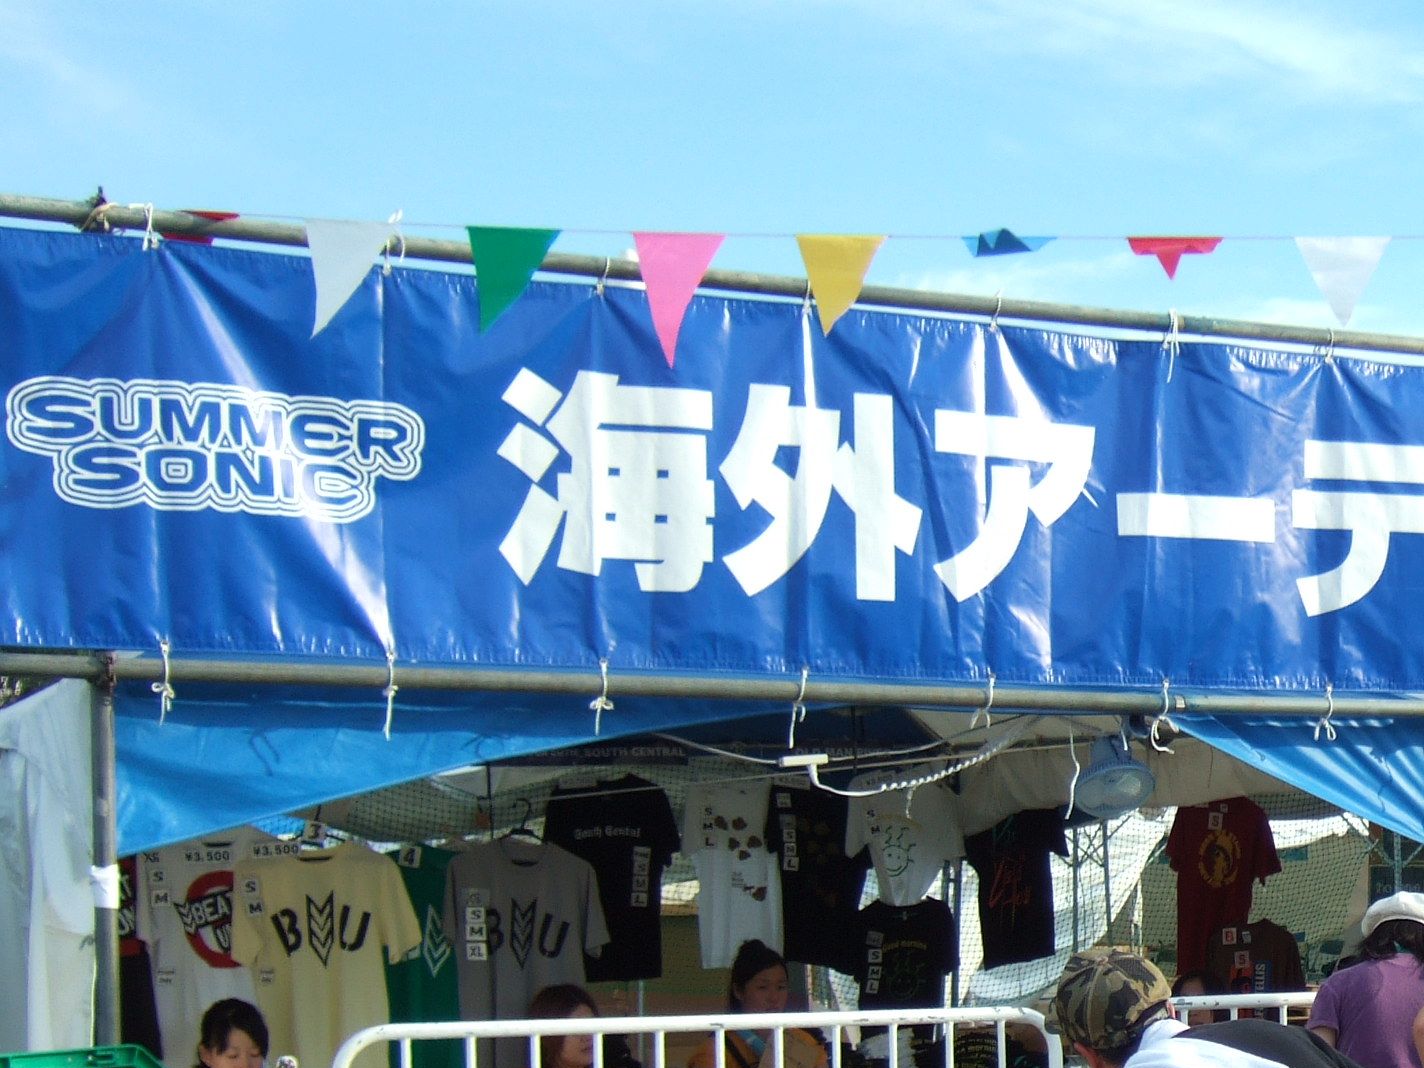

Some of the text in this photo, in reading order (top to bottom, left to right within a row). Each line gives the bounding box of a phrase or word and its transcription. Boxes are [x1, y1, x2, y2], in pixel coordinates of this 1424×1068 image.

[16, 385, 417, 467] SUMMER
[62, 442, 370, 513] SONIC
[631, 745, 686, 757] CENTRAL
[1211, 815, 1220, 827] S
[310, 823, 320, 838] 3
[705, 837, 715, 847] L
[404, 848, 416, 865] 4
[153, 871, 164, 881] S
[245, 881, 256, 893] S
[154, 892, 168, 904] M
[249, 901, 262, 914] M
[472, 909, 482, 920] S
[470, 926, 483, 936] M
[469, 946, 483, 957] XL
[872, 950, 880, 960] S
[1238, 955, 1247, 966] S
[870, 969, 880, 978] M
[869, 982, 878, 992] L
